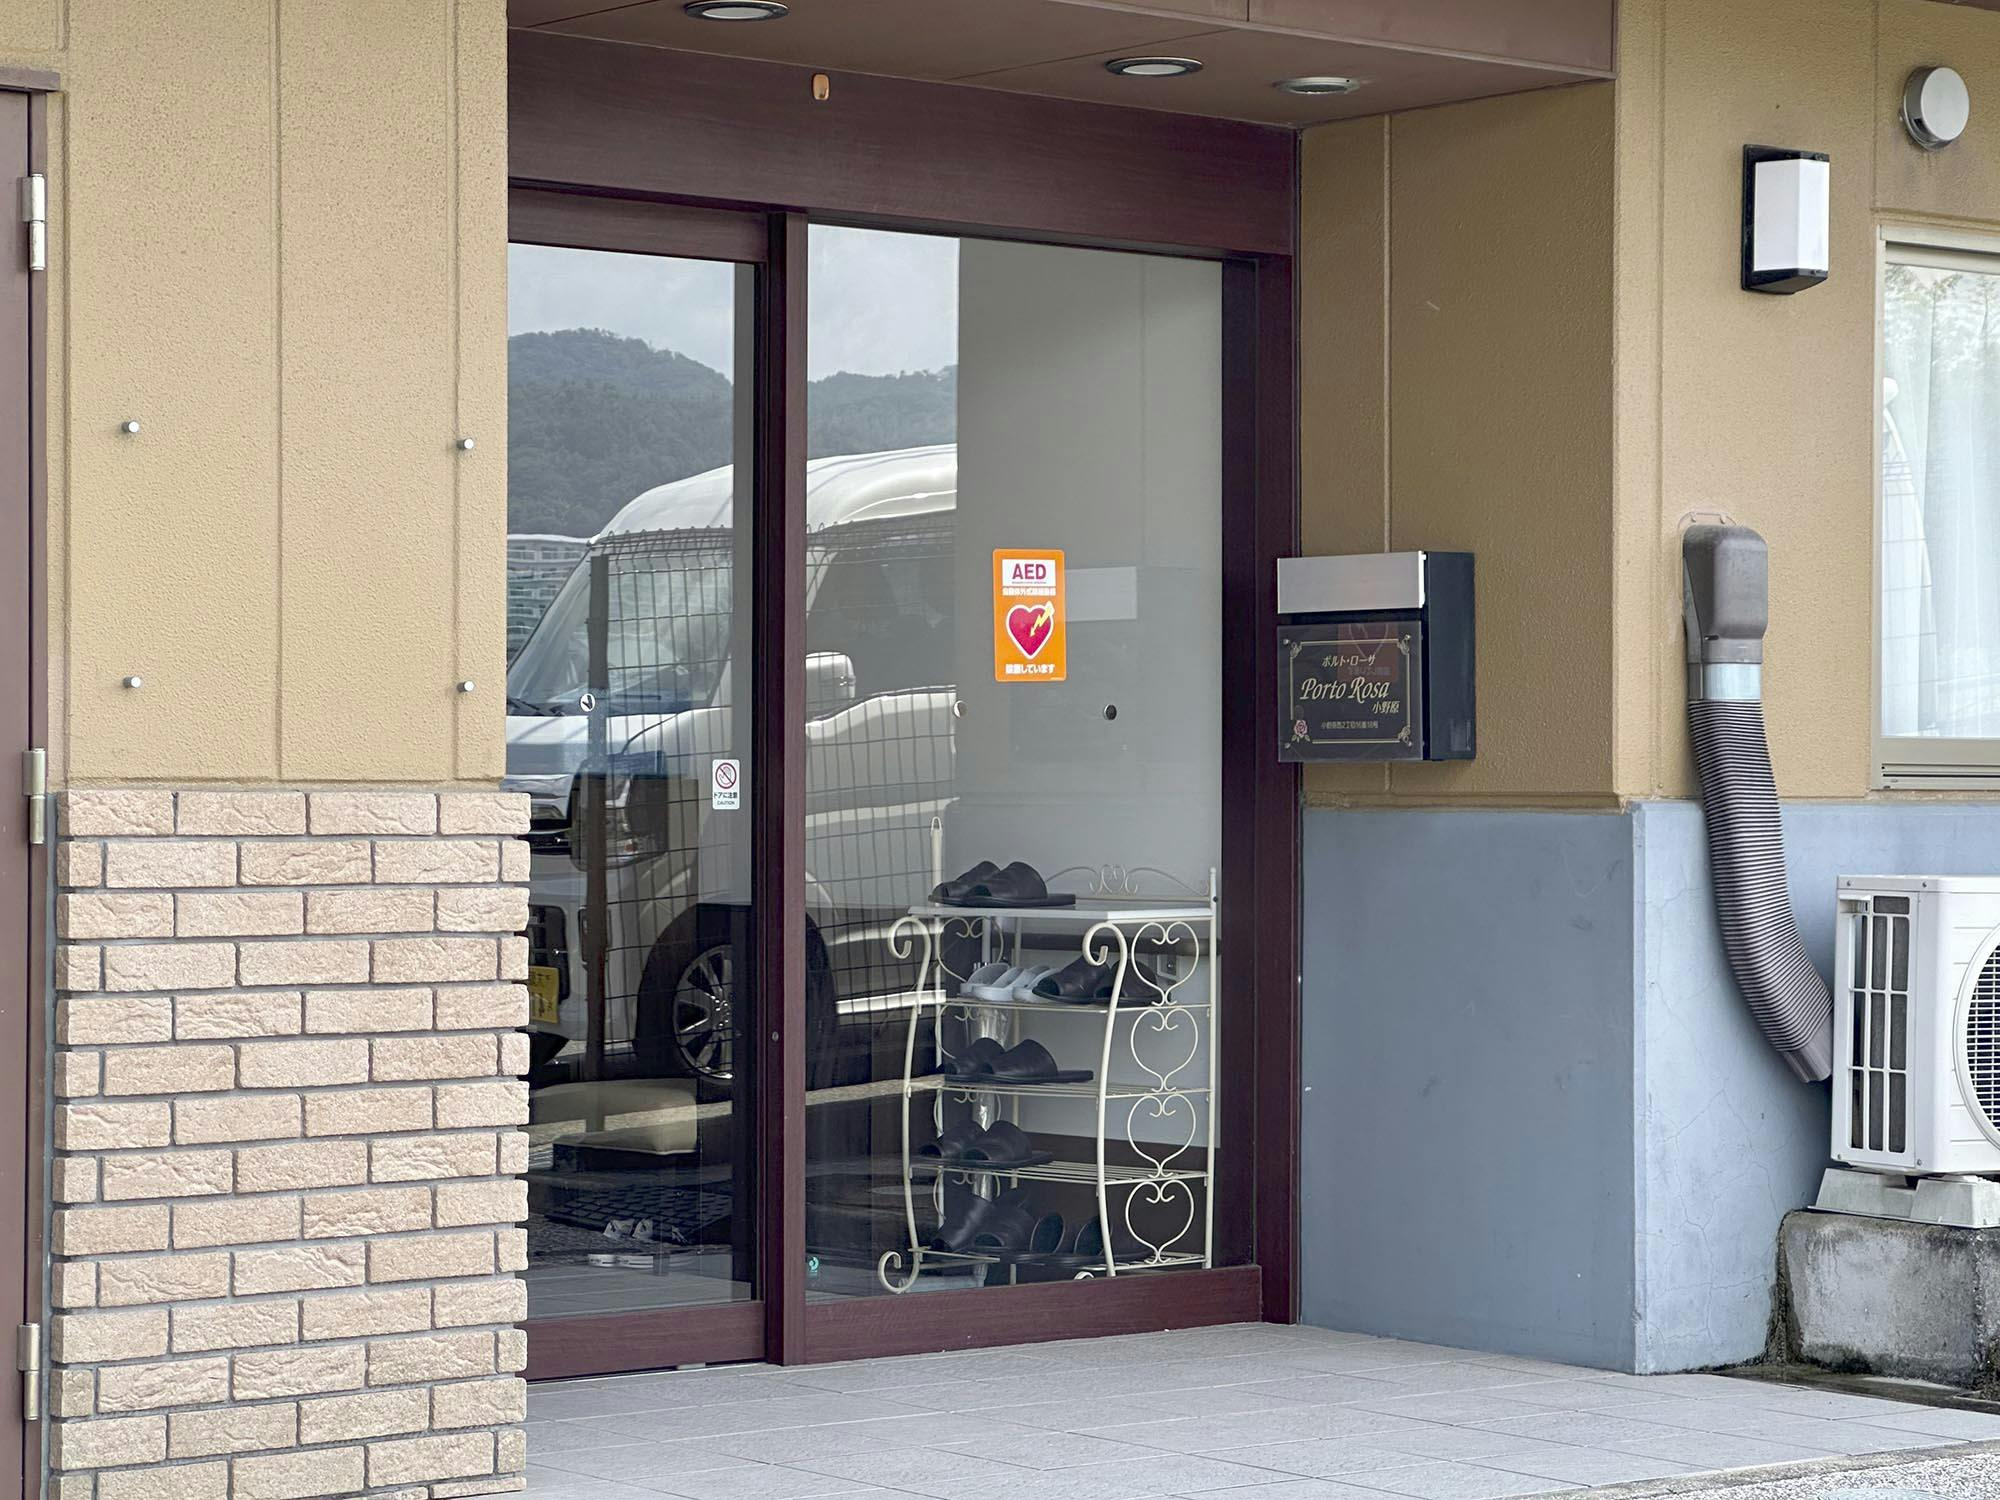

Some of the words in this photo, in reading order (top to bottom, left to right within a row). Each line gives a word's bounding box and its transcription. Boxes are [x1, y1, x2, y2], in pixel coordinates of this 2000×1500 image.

[1012, 563, 1046, 579] AED
[1300, 678, 1346, 700] Porto
[1348, 677, 1390, 703] Rosa
[1373, 701, 1400, 713] 小野原
